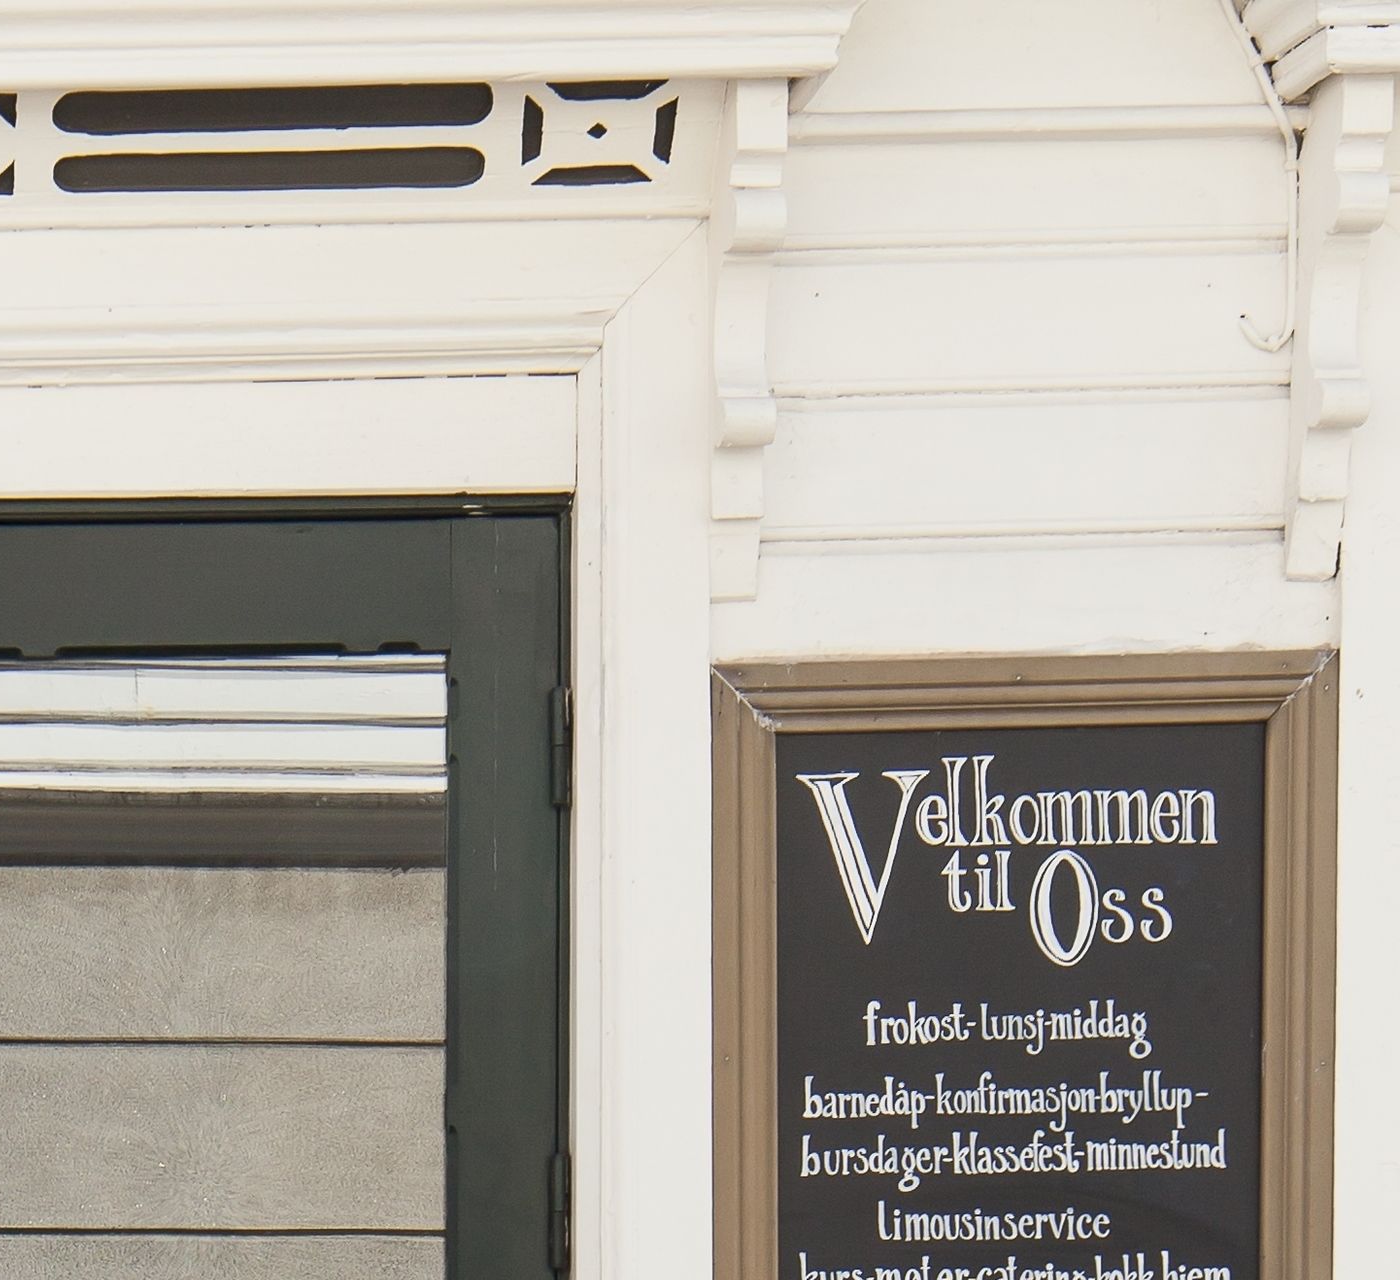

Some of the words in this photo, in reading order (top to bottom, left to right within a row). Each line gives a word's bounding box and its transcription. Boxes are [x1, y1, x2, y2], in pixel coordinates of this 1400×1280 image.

[796, 754, 1218, 946] Velkommen
[941, 850, 1016, 912] til
[1030, 849, 1173, 967] Oss
[877, 1200, 1111, 1242] limousinservice
